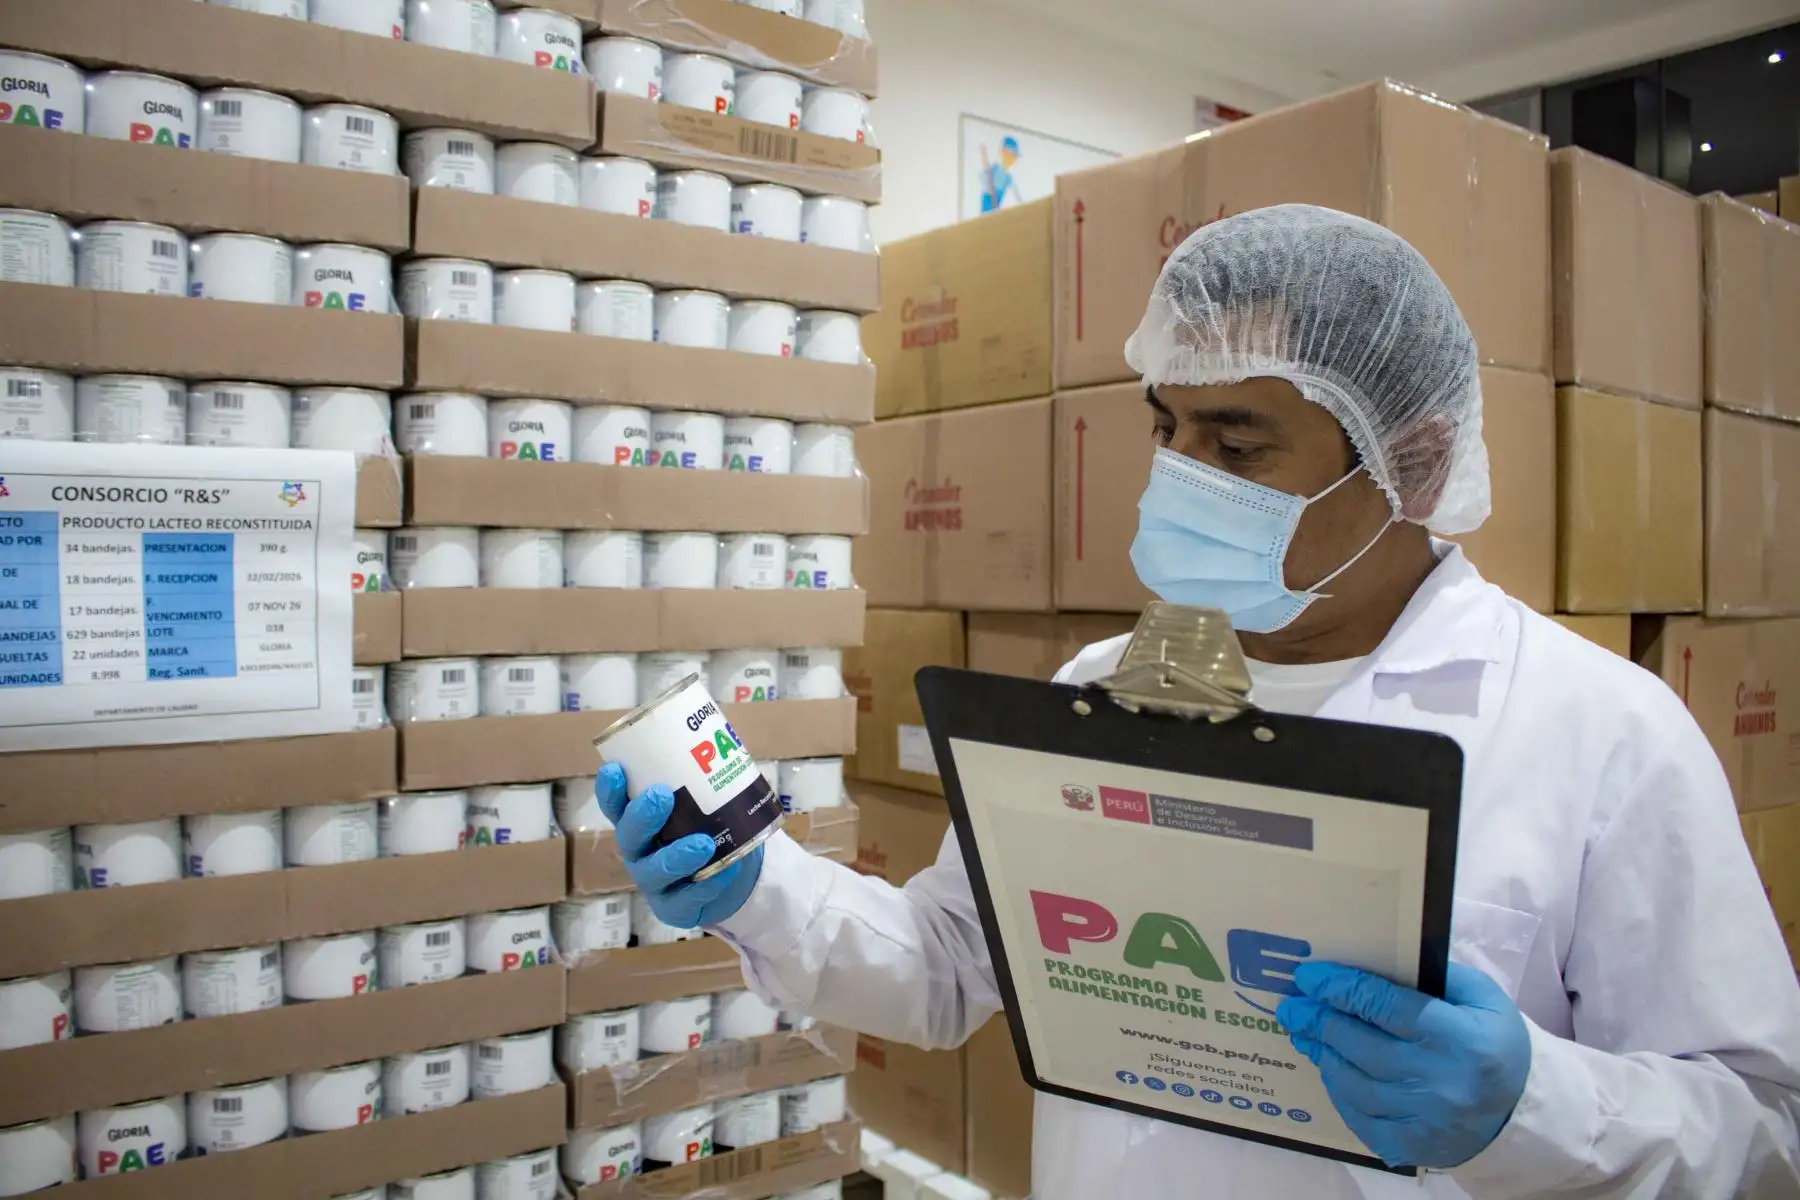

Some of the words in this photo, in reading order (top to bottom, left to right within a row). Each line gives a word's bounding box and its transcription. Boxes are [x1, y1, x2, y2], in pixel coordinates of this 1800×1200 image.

[1, 77, 50, 98] GLORIA
[143, 101, 184, 123] GLORIA
[130, 122, 191, 148] PAE
[314, 268, 354, 284] GLORIA
[304, 291, 365, 312] PAE
[508, 421, 545, 436] GLORIA
[500, 441, 555, 461] PAE
[51, 486, 168, 503] CONSORCIO
[62, 517, 144, 529] PRODUCTO
[149, 518, 202, 530] LACTEO
[206, 518, 312, 530] RECONSTITUIDA
[17, 536, 43, 546] POR
[65, 544, 79, 552] 34
[144, 544, 227, 553] PRESENTACION
[2, 568, 18, 577] DE
[66, 575, 79, 584] 18
[158, 574, 218, 583] RECEPCION
[23, 600, 38, 609] DE
[69, 607, 82, 616] 17
[263, 602, 286, 611] NOV
[146, 611, 223, 621] VENCIMIENTO
[0, 631, 56, 641] ANDEJAS
[66, 630, 87, 640] 629
[90, 629, 141, 642] bandejas
[147, 628, 175, 637] LOTE
[72, 651, 86, 660] 22
[89, 649, 140, 660] unidades
[148, 647, 189, 657] MARCA
[735, 686, 776, 703] PAE
[686, 701, 719, 732] GLORIA
[1105, 797, 1145, 813] PERÚ
[1155, 799, 1217, 816] Ministerio
[1157, 808, 1172, 817] de
[1174, 810, 1237, 827] Desarrollo
[1224, 826, 1260, 840] Social
[1029, 889, 1312, 997] PAE
[502, 946, 549, 971] PAE
[1044, 958, 1169, 996] PROGRAMA
[1176, 985, 1204, 1003] DE
[1119, 1027, 1297, 1071] www.gob.pe/pae
[1147, 1063, 1195, 1080] redes
[1199, 1074, 1276, 1097] sociales!
[1242, 1073, 1265, 1083] en
[107, 1125, 151, 1142] GLORIA
[98, 1142, 166, 1174] PAE
